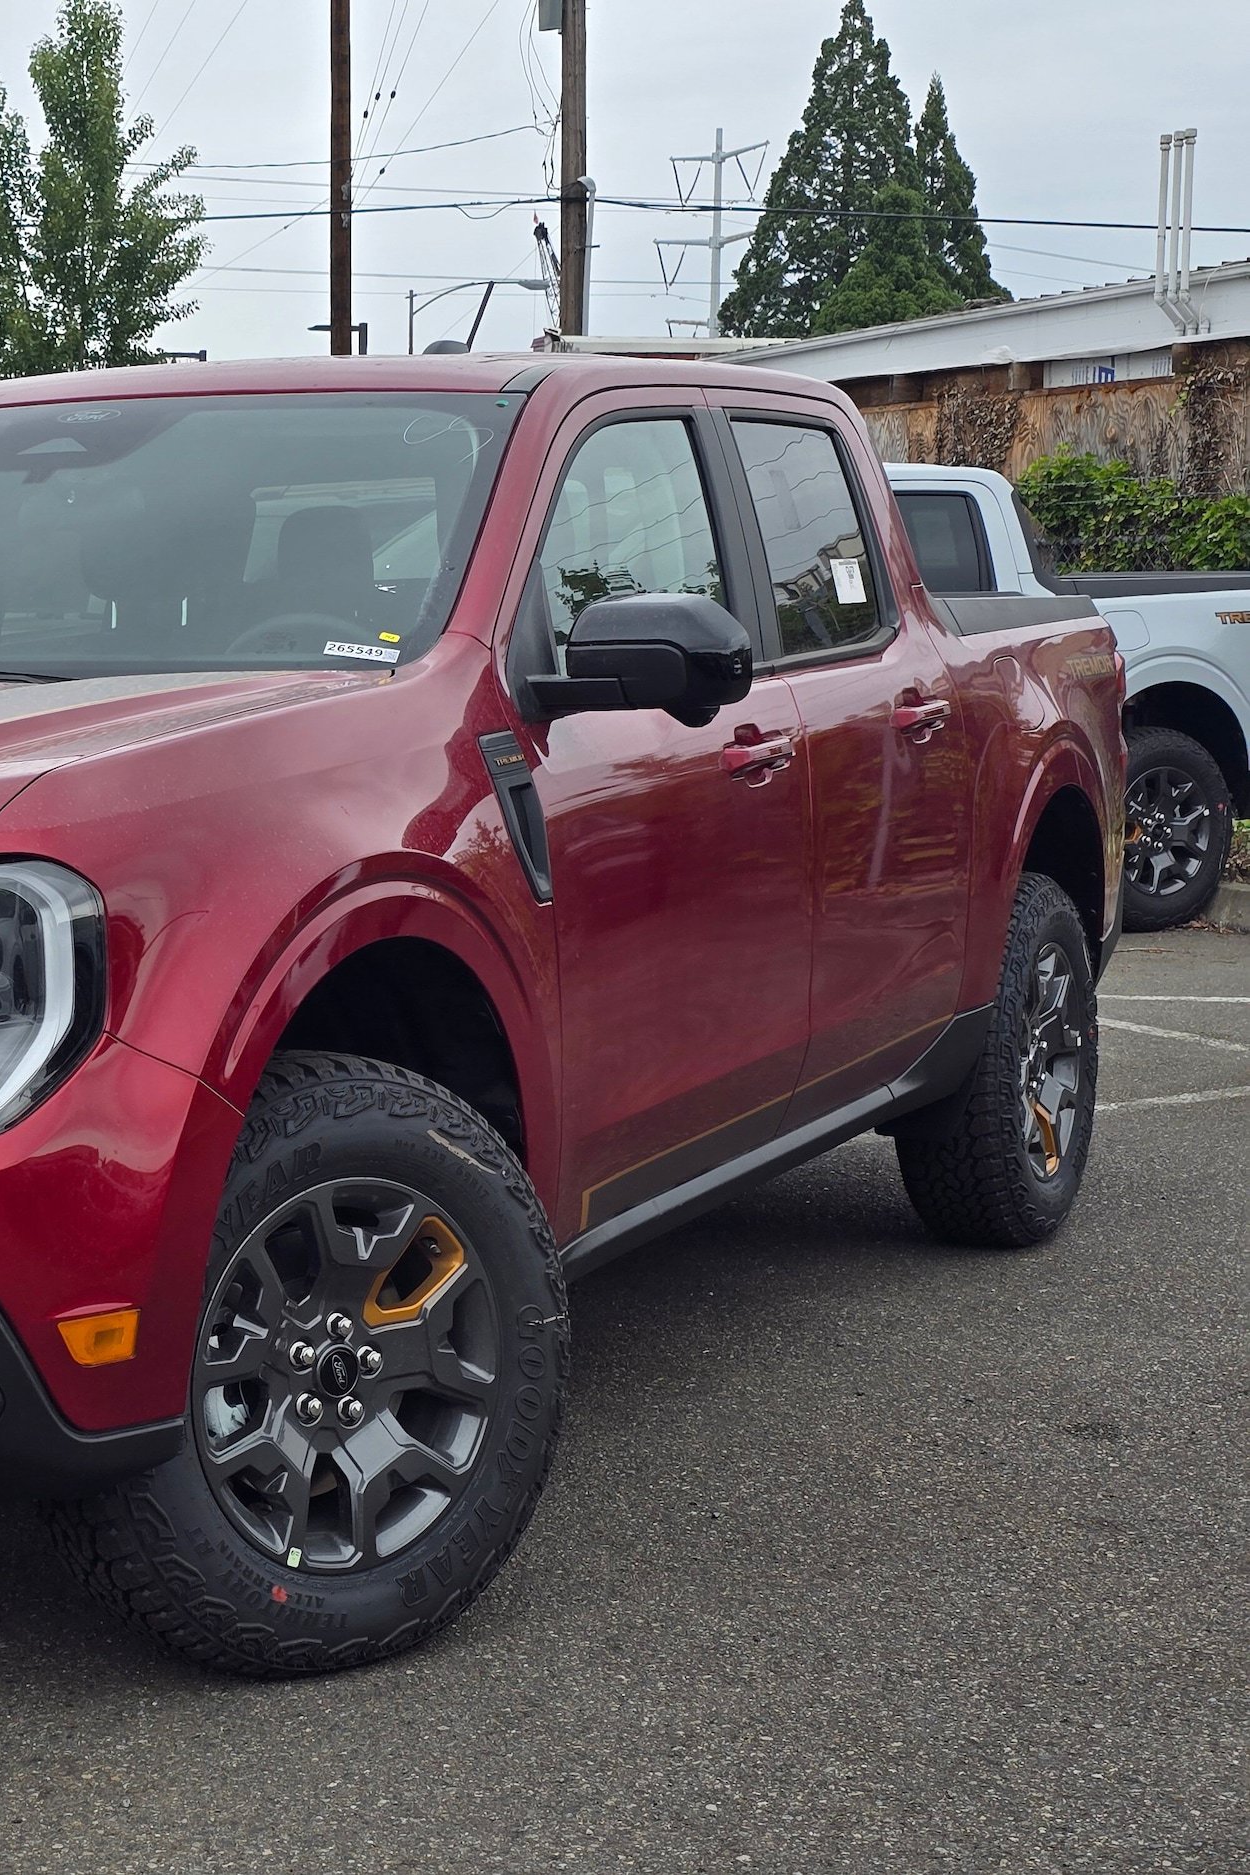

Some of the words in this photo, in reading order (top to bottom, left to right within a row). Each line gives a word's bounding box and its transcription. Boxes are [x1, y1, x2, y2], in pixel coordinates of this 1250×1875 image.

[327, 643, 383, 657] 265549
[1065, 653, 1115, 681] TREMOR
[397, 1302, 547, 1608] GOODYEAR
[215, 1539, 326, 1609] ALL-ERRAIN
